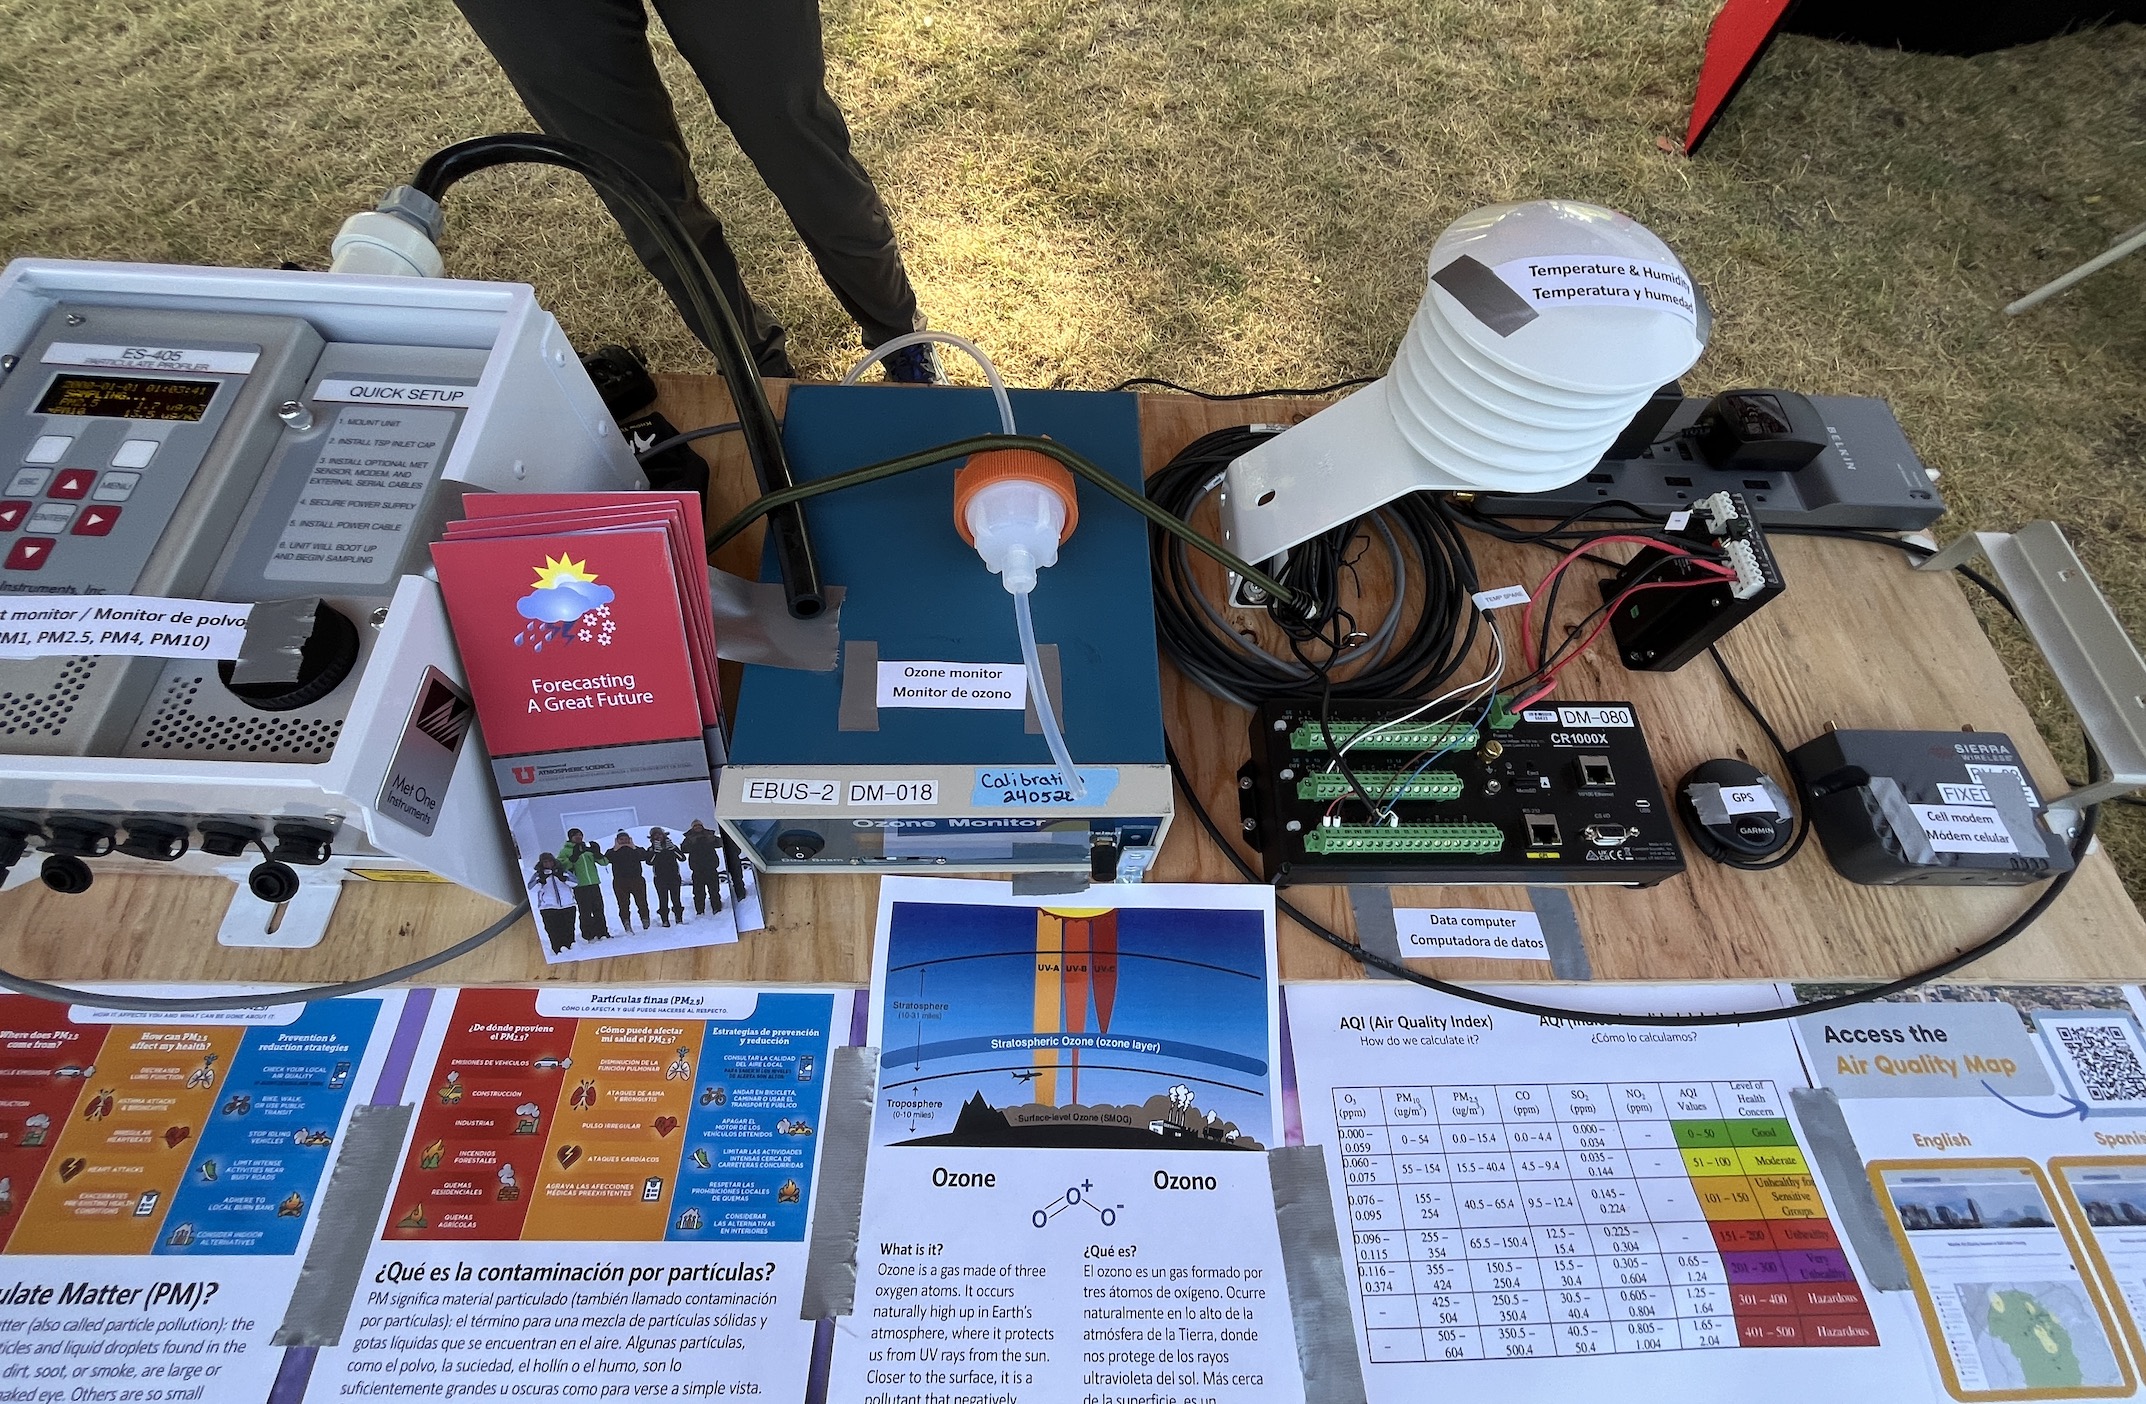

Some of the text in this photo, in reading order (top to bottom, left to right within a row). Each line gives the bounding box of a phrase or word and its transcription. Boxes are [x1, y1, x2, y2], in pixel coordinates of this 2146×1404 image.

[1529, 264, 1625, 277] Temperature
[1630, 265, 1640, 276] &
[1532, 286, 1694, 314] Temperatura y humedad
[121, 348, 183, 362] ES-405
[84, 358, 210, 371] PARTICULATE PROFILER
[350, 386, 464, 401] QUICK SETUP
[1827, 427, 1856, 470] BELKIN
[372, 523, 402, 531] CABLE
[11, 609, 78, 620] monitor
[94, 608, 166, 621] Monitor
[170, 612, 193, 623] de
[196, 614, 245, 628] polvo
[37, 631, 210, 650] PM2.5, PM4, PM10)
[904, 667, 1002, 678] Ozone monitor
[532, 674, 635, 698] Forecasting
[893, 687, 1011, 698] Monitor de ozono
[528, 692, 653, 713] A Great Future
[1564, 711, 1628, 724] DM-080
[1551, 733, 1608, 744] CR1000X
[1954, 744, 2010, 754] SIERRA
[512, 766, 536, 784] U
[981, 773, 1084, 788] Calibrati
[392, 774, 435, 810] Met One
[750, 782, 833, 800] EBUS-2
[852, 784, 932, 801] DM-018
[1732, 793, 1754, 802] GPS
[386, 790, 432, 825] Instruments
[852, 818, 1046, 828] Ozone Monitor
[1927, 812, 1994, 824] Cell modem
[1740, 826, 1774, 835] GARMIN
[1926, 830, 2009, 843] Módem celular
[1430, 915, 1516, 929] Data computer
[1411, 934, 1544, 948] Computadora de datos
[1038, 964, 1060, 972] UV-A
[591, 995, 641, 1003] Partículas
[893, 1001, 948, 1011] Stratosphere
[468, 1024, 554, 1033] ¿De dónde proviene
[1340, 1015, 1492, 1032] AQI (Air Quality Index)
[278, 1034, 327, 1042] Prevention
[712, 1028, 758, 1036] Estrategias
[772, 1028, 820, 1037] prevención
[1592, 1032, 1697, 1044] ¿Cómo lo calculamos?
[1825, 1024, 1947, 1043] Access the
[740, 1038, 746, 1046] y
[992, 1036, 1161, 1054] Stratospheric Ozone (ozone layer)
[1360, 1036, 1383, 1046] How
[1387, 1036, 1400, 1045] do
[1421, 1035, 1464, 1045] calculate
[1467, 1035, 1479, 1044] it?
[258, 1043, 349, 1053] reduction strategies
[1838, 1054, 2016, 1078] Air Quality Map
[1516, 1091, 1530, 1100] CO
[1680, 1088, 1697, 1099] AQI
[1737, 1094, 1766, 1103] Health
[887, 1099, 942, 1109] Troposphere
[1677, 1102, 1707, 1110] Values
[1738, 1108, 1774, 1116] Concern
[1018, 1113, 1070, 1123] Surface-level
[1101, 1114, 1131, 1125] (SMOG)
[1752, 1128, 1776, 1137] Good
[1913, 1133, 1972, 1151] English
[2094, 1131, 2146, 1149] Spanis
[1345, 1143, 1370, 1153] 0.059
[1755, 1156, 1796, 1165] Moderate
[933, 1168, 995, 1187] Ozone
[1154, 1170, 1216, 1190] Ozono
[1772, 1191, 1810, 1201] Sensitive
[881, 1243, 943, 1255] What is it?
[1084, 1245, 1136, 1258] ¿Qué es?
[376, 1262, 775, 1286] ¿Qué es la contaminación por partículas?
[878, 1263, 1046, 1279] Ozone is a gas made of three
[57, 1282, 219, 1311] Matter (PM)?
[368, 1292, 568, 1308] PM significa material particulado
[1808, 1292, 1858, 1304] Hazardous
